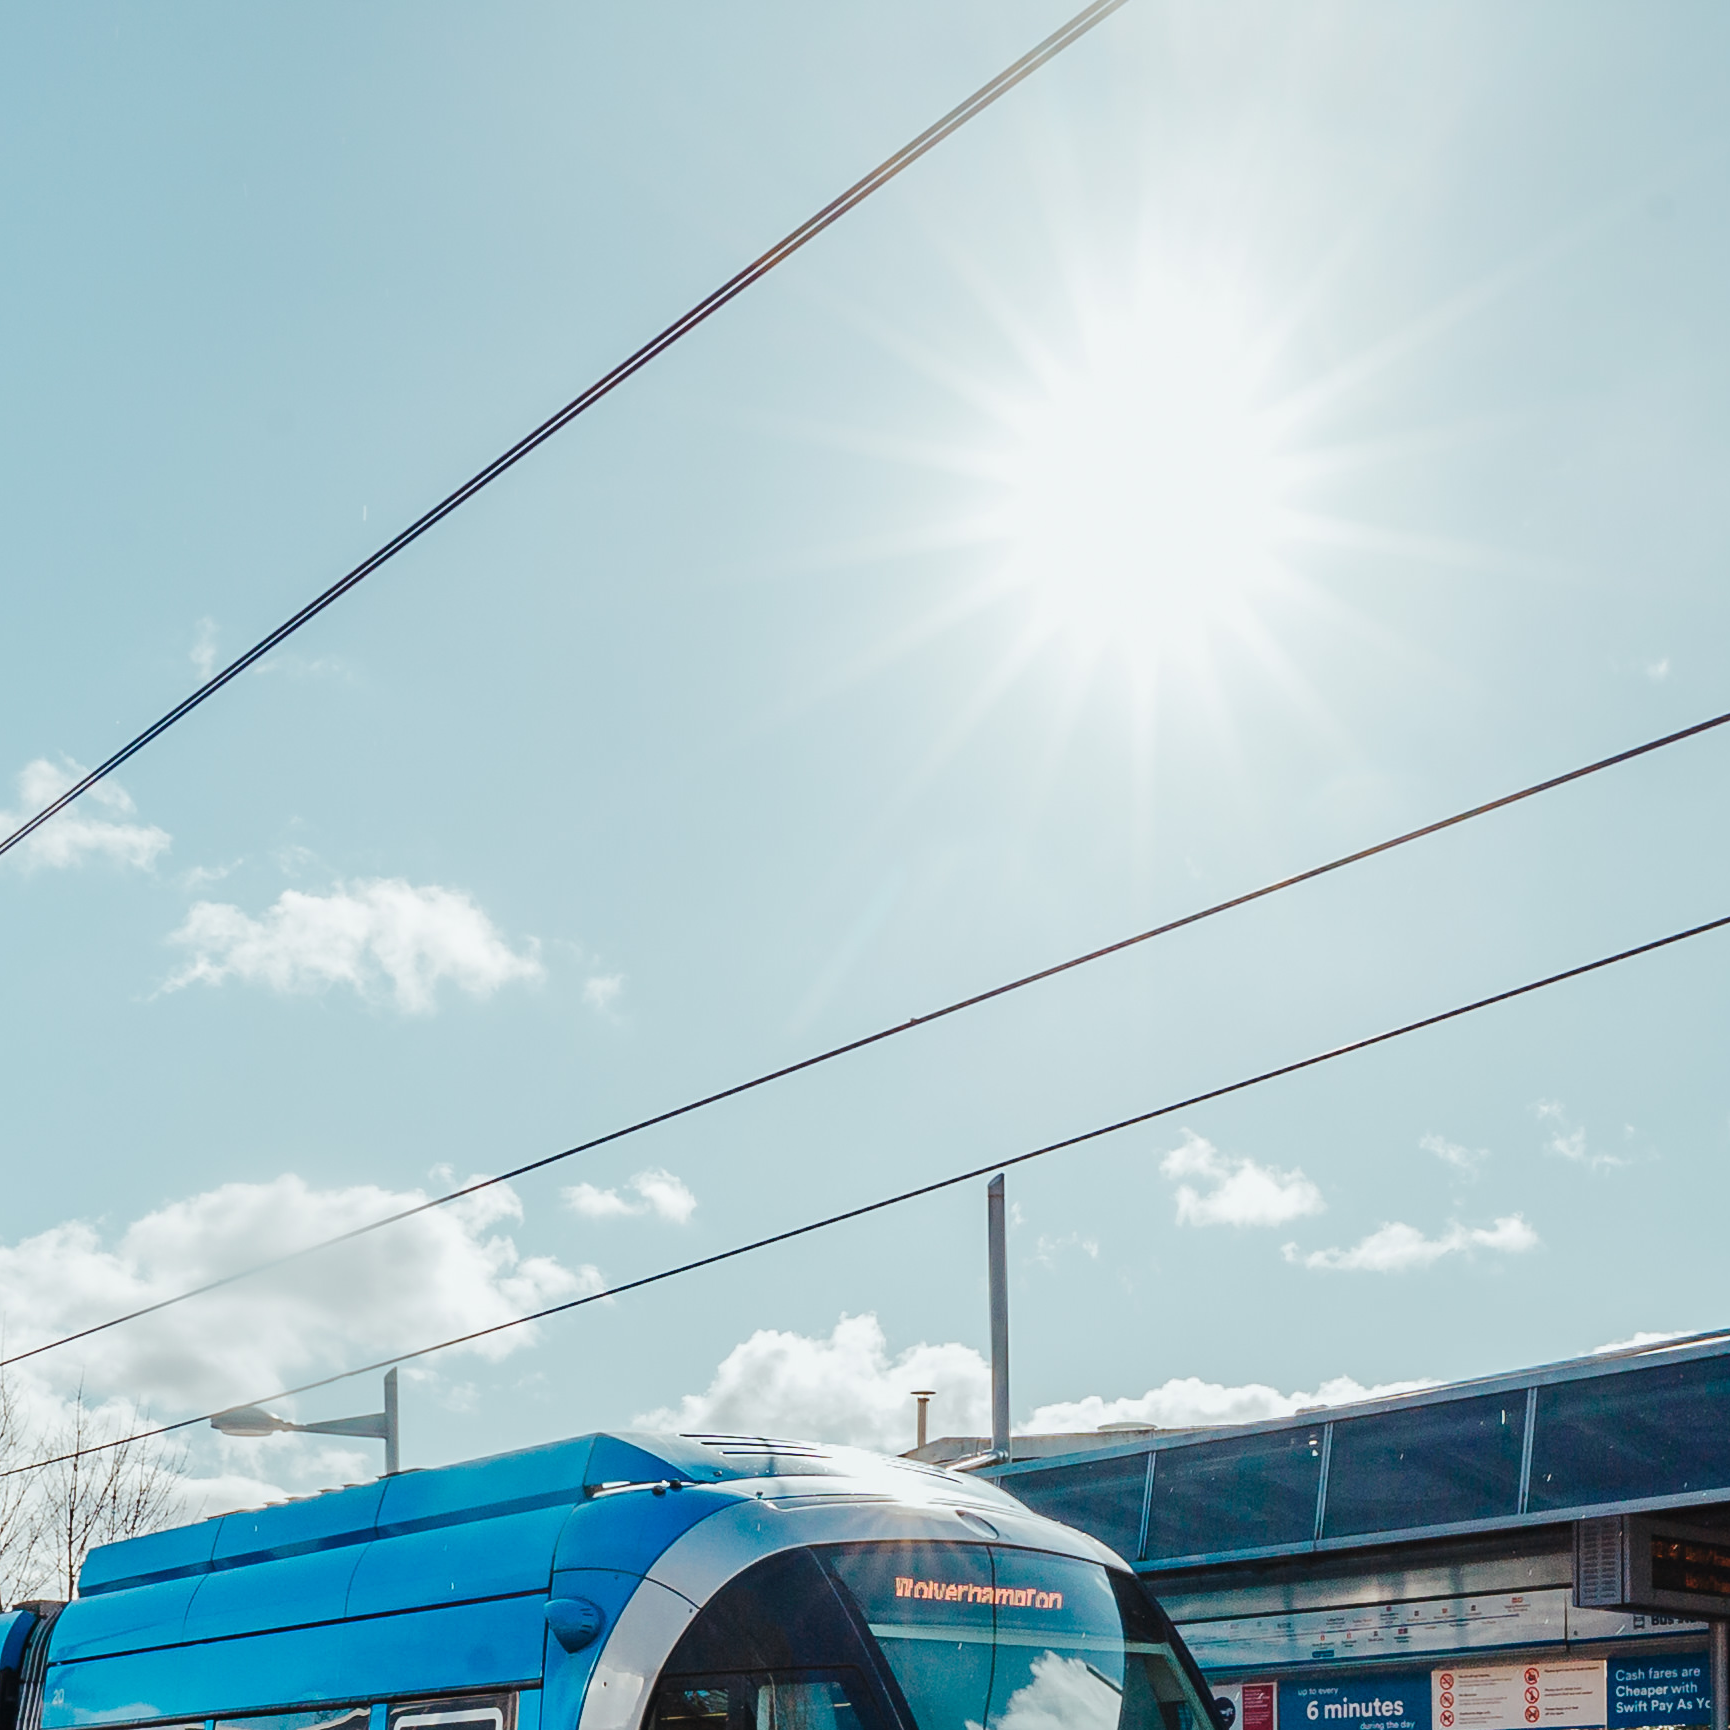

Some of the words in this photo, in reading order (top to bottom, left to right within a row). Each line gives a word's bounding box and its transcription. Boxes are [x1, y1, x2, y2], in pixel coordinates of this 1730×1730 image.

[1615, 1668, 1645, 1682] Cash
[1648, 1667, 1678, 1680] fares
[1681, 1667, 1701, 1677] are
[1297, 1688, 1308, 1697] up
[1309, 1688, 1317, 1696] to
[1318, 1687, 1339, 1696] every
[1615, 1685, 1668, 1698] Cheaper
[1670, 1681, 1698, 1694] with
[1306, 1700, 1319, 1720] 6
[1324, 1697, 1404, 1719] minutes
[1616, 1700, 1648, 1714] Swift
[1651, 1700, 1674, 1714] Pay
[1677, 1698, 1693, 1711] As
[1696, 1697, 1711, 1709] Yo
[1360, 1721, 1385, 1730] during
[1386, 1720, 1399, 1729] the
[1400, 1720, 1415, 1730] day
